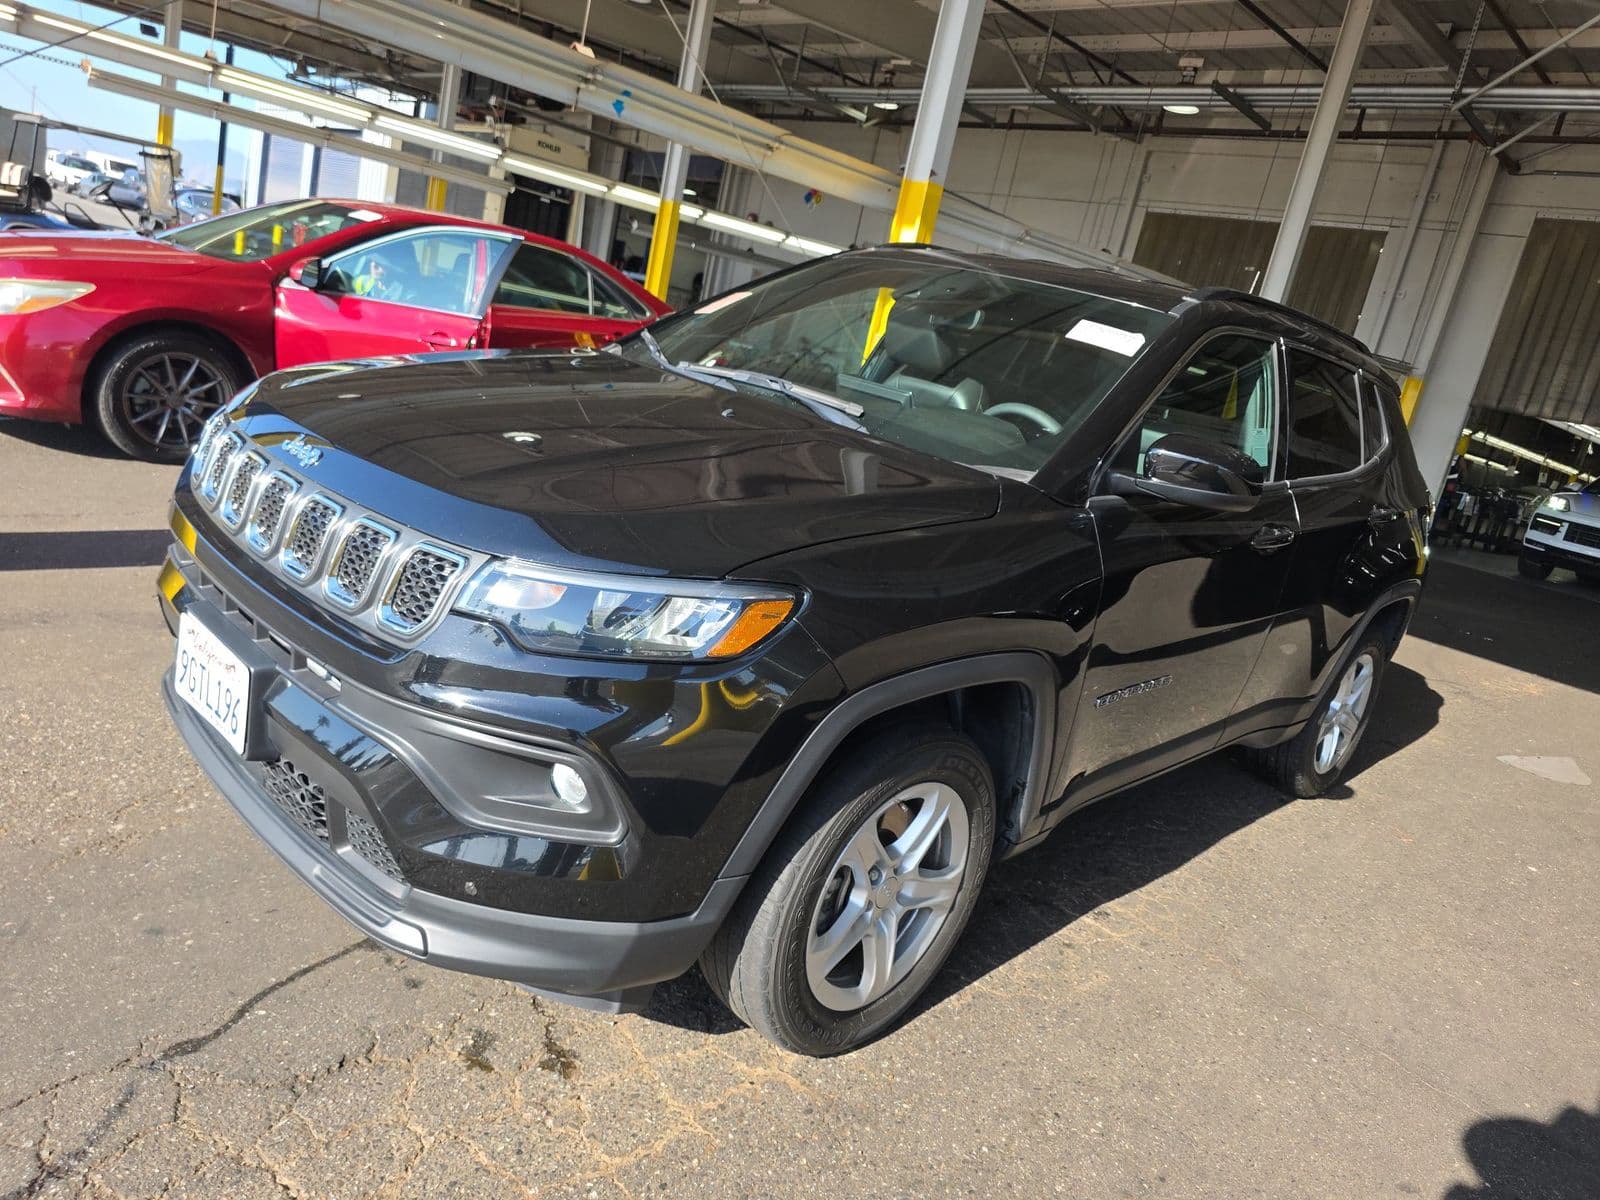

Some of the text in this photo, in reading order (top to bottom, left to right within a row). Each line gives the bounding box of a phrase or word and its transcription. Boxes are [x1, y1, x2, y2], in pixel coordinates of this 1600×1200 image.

[537, 140, 561, 153] KOHLER
[281, 433, 321, 469] Jeep
[179, 649, 241, 735] 9GTL196
